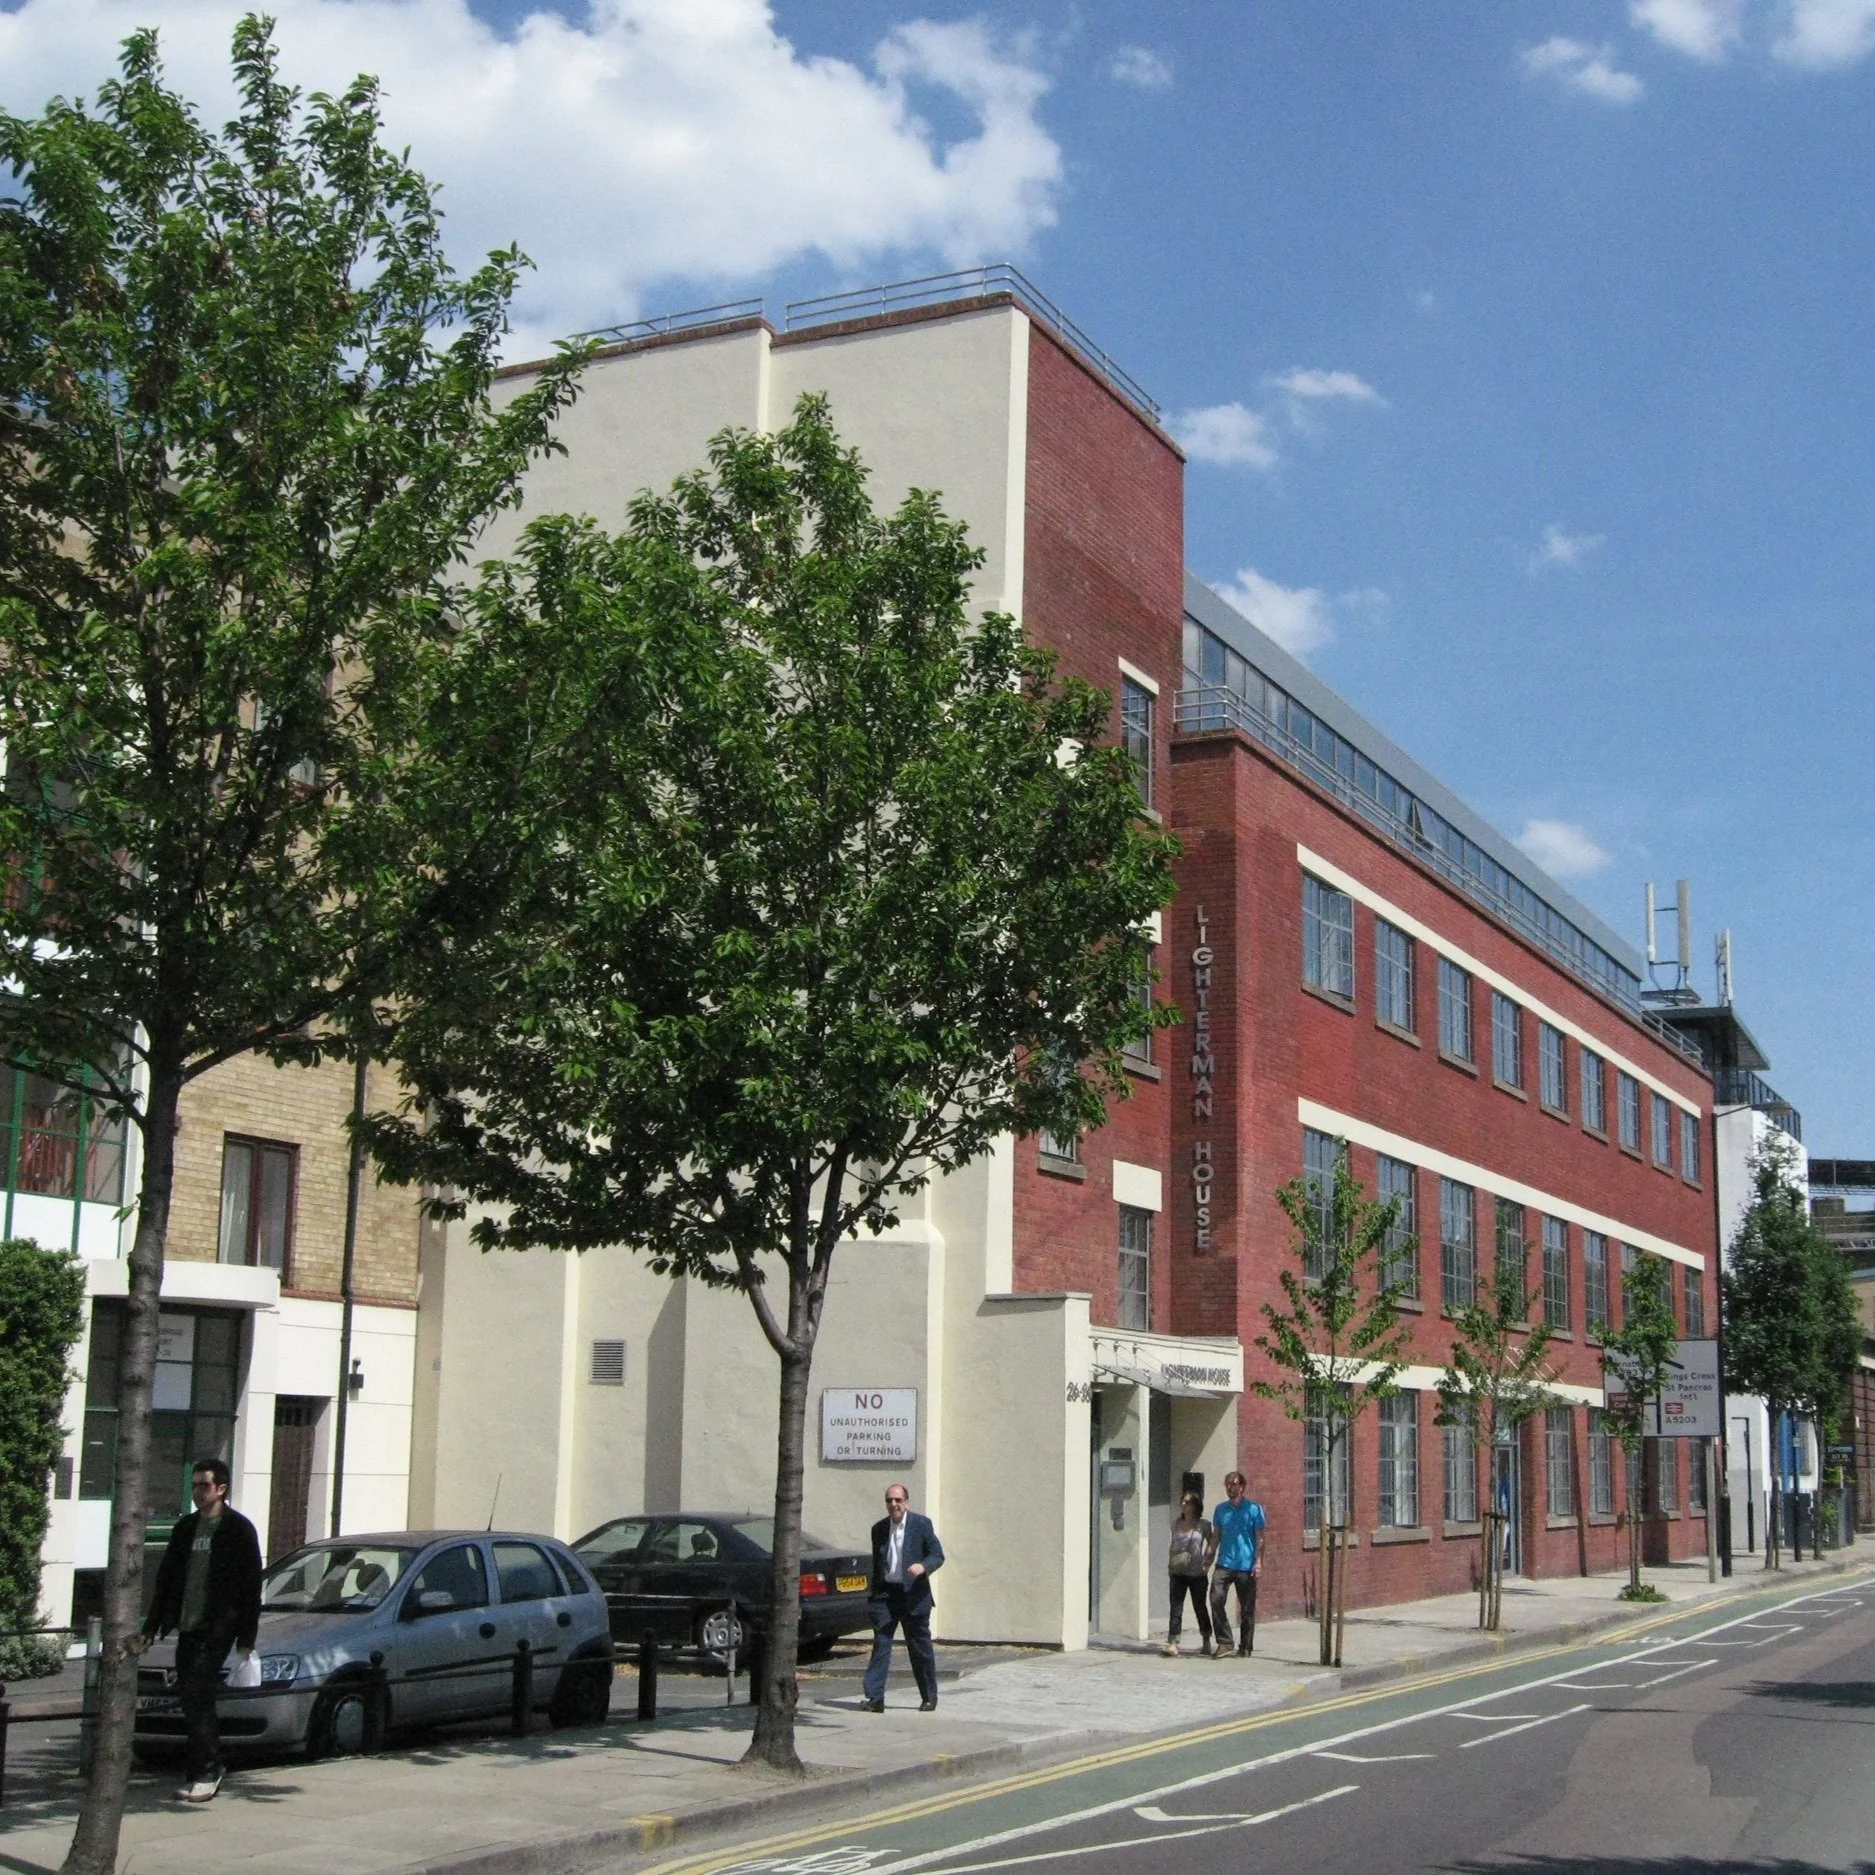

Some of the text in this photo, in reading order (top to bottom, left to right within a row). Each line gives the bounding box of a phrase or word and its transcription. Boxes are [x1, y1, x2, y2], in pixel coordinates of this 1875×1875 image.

[1192, 905, 1214, 1248] LIGHTERMAN HOUSE
[1691, 1372, 1716, 1380] Cross
[855, 1394, 883, 1409] NO
[830, 1418, 909, 1427] UNAUTHORISED
[1665, 1416, 1697, 1424] A5203
[846, 1432, 892, 1441] PARKING
[837, 1446, 902, 1456] OR TURNING
